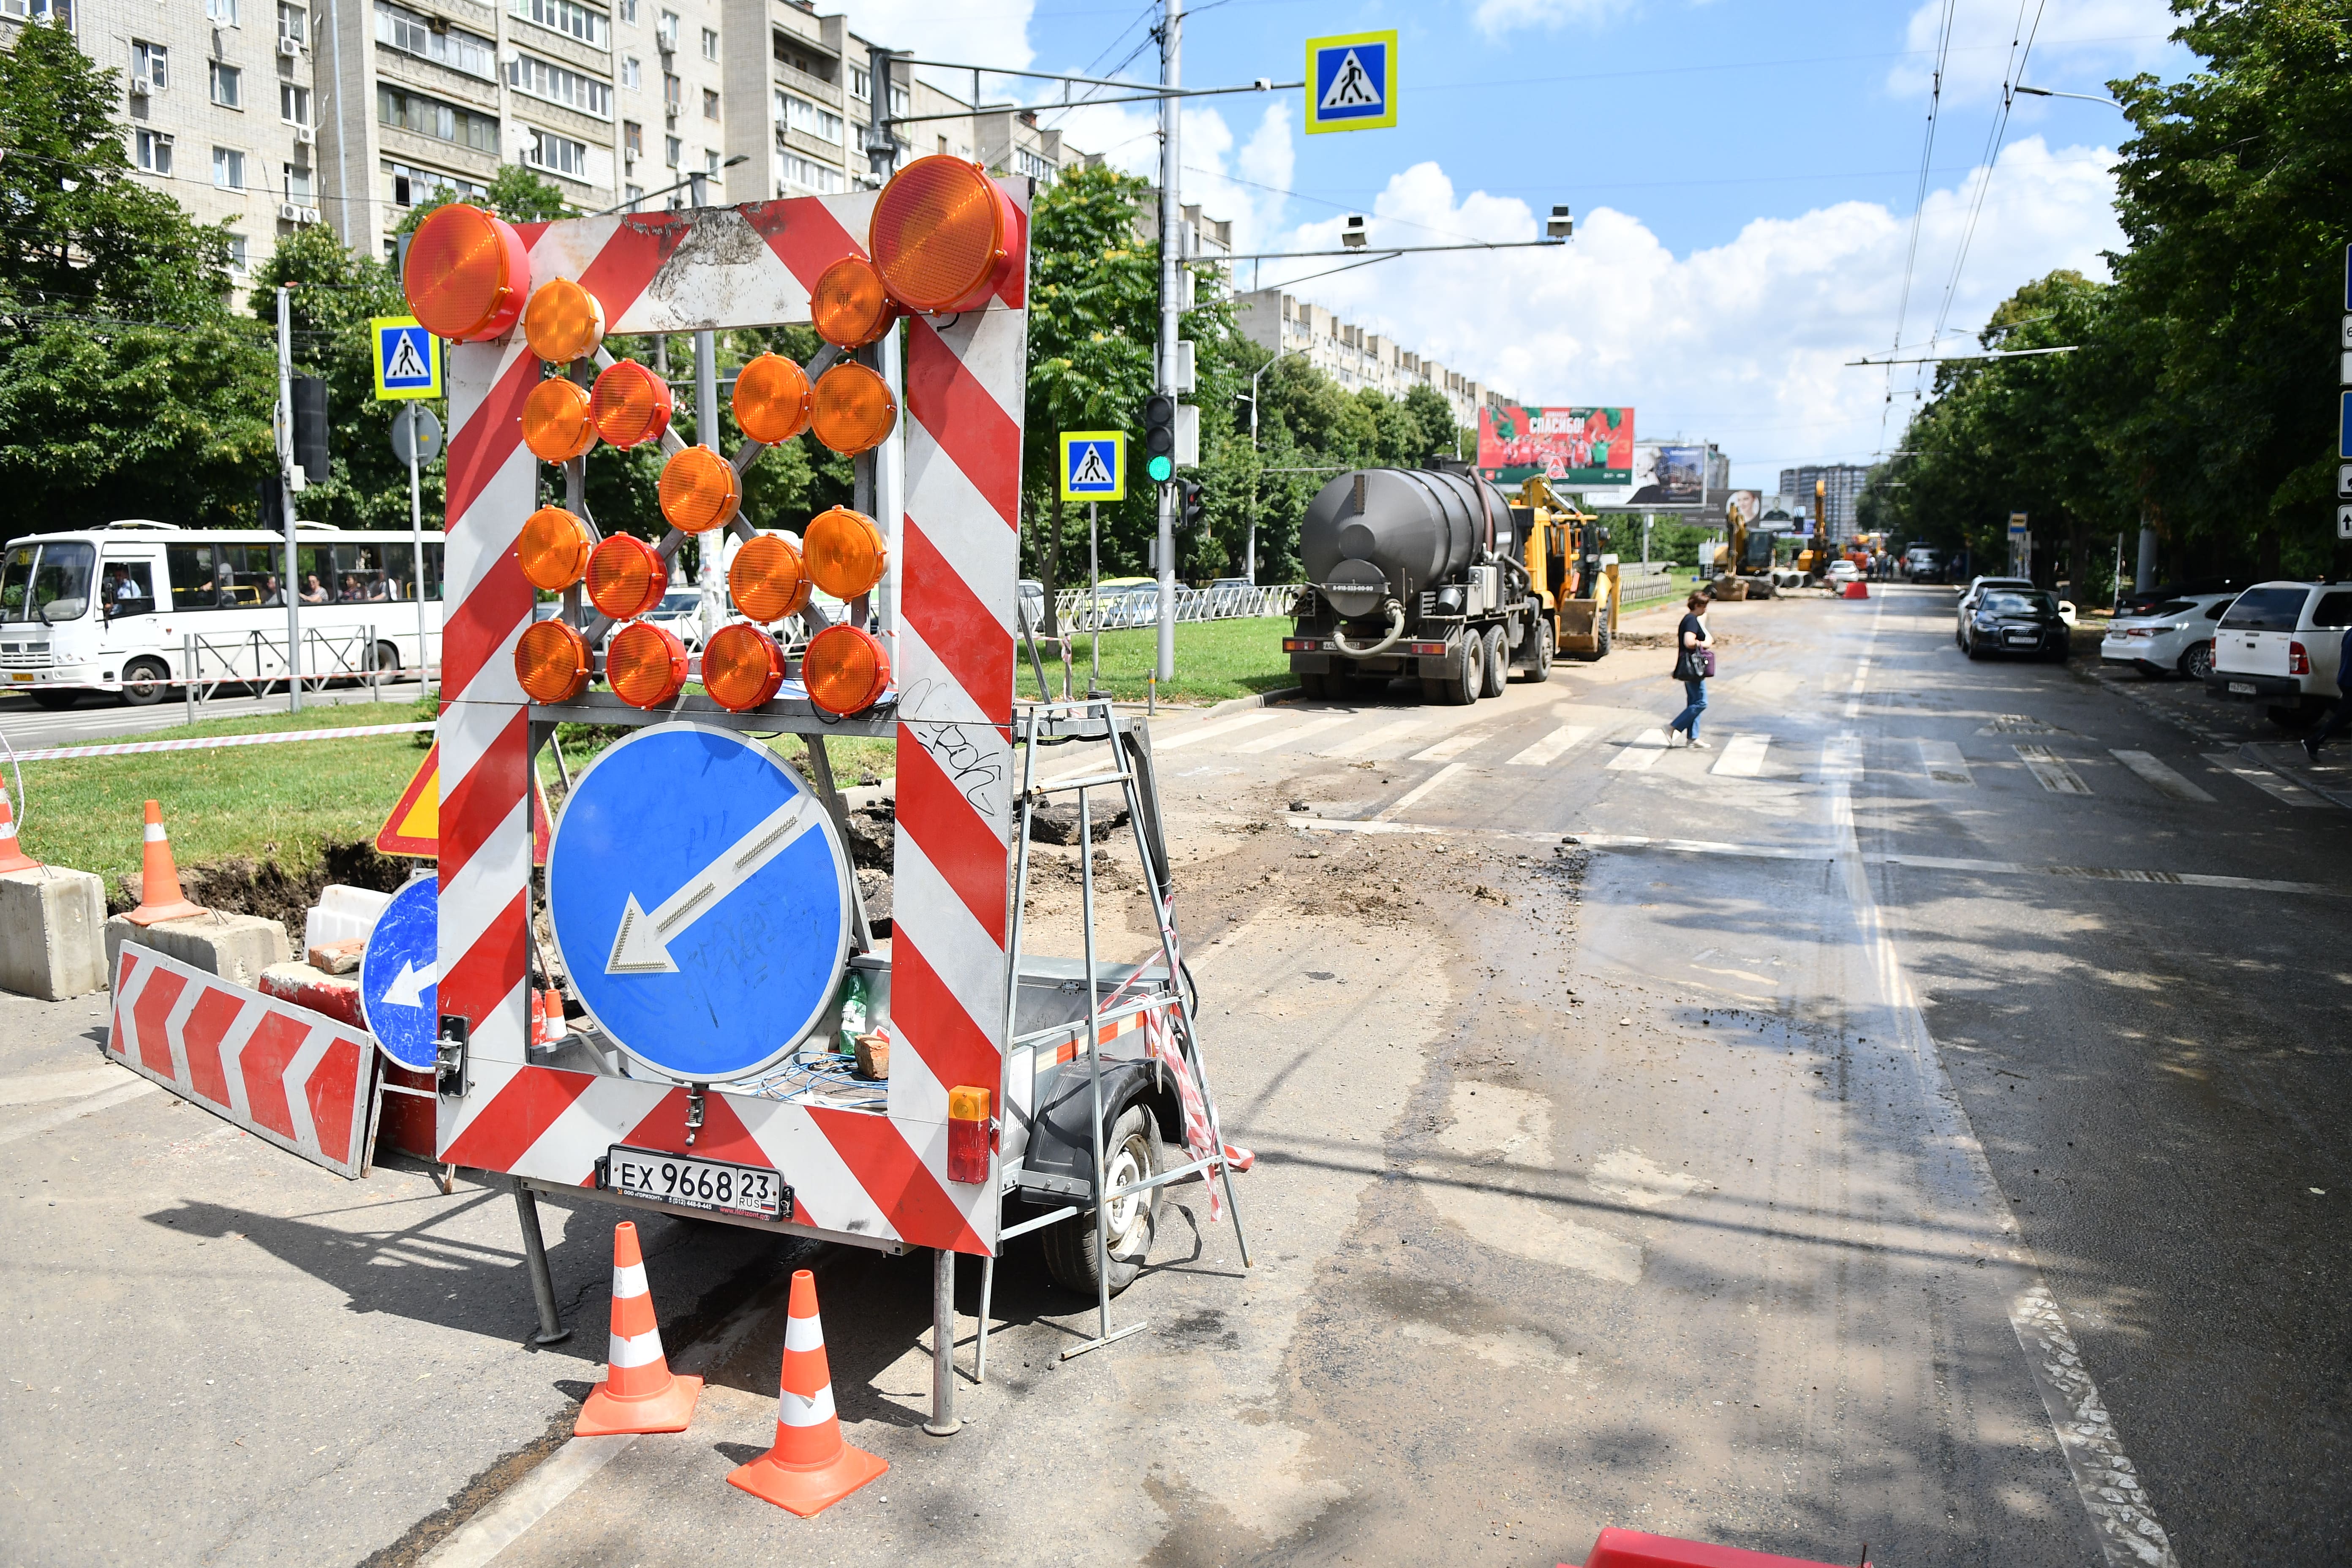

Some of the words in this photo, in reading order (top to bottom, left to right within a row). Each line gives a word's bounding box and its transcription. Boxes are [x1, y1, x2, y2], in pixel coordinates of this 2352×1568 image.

[1529, 417, 1585, 434] СПАСИБО!
[1004, 1116, 1027, 1135] канал
[662, 1163, 732, 1202] 9668
[741, 1173, 769, 1199] 23
[634, 1192, 663, 1201] «ГОРИЗОНТ»
[739, 1197, 760, 1208] RUS
[686, 1200, 712, 1210] 448-9-445
[719, 1206, 770, 1221] www.horizont.pro
